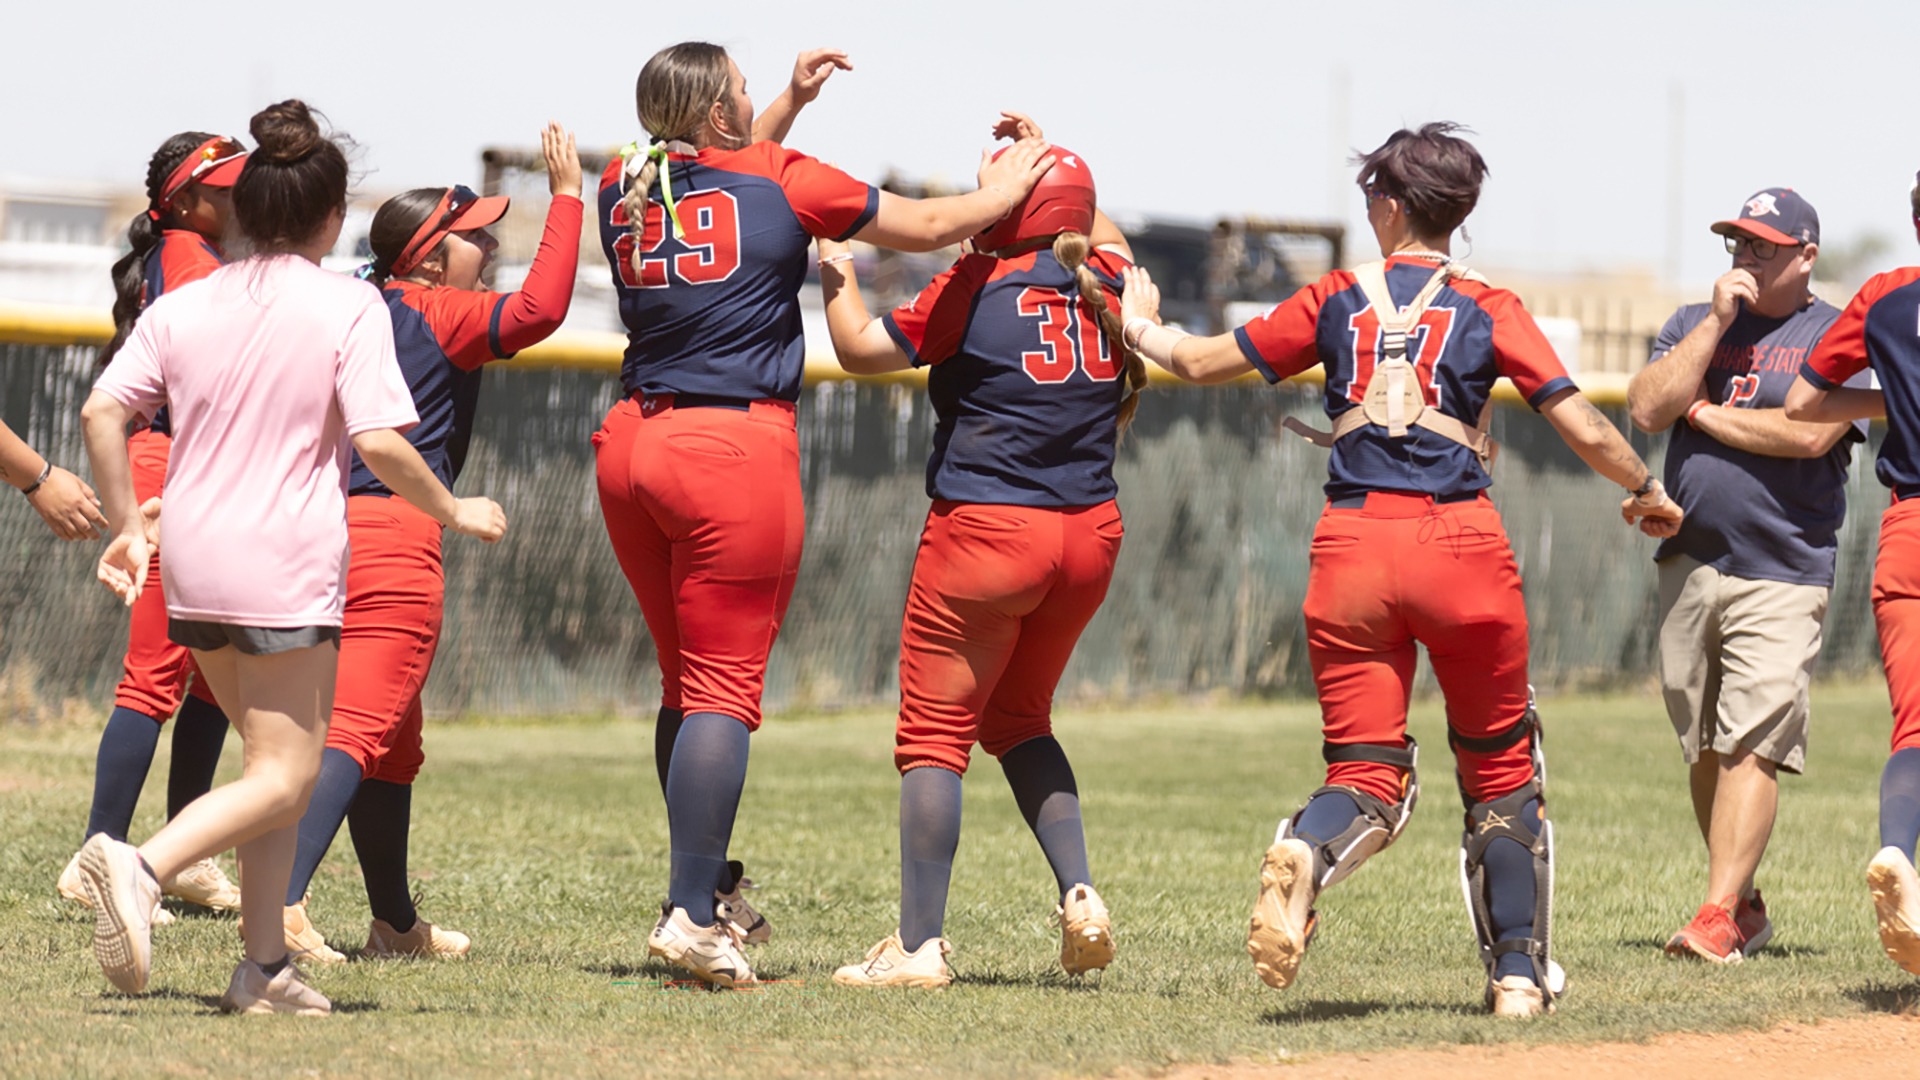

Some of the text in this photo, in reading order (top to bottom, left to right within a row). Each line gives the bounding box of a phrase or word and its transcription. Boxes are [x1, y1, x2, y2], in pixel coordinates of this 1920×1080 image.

[610, 187, 741, 289] 29
[1016, 285, 1126, 384] 30
[1345, 302, 1457, 409] 17
